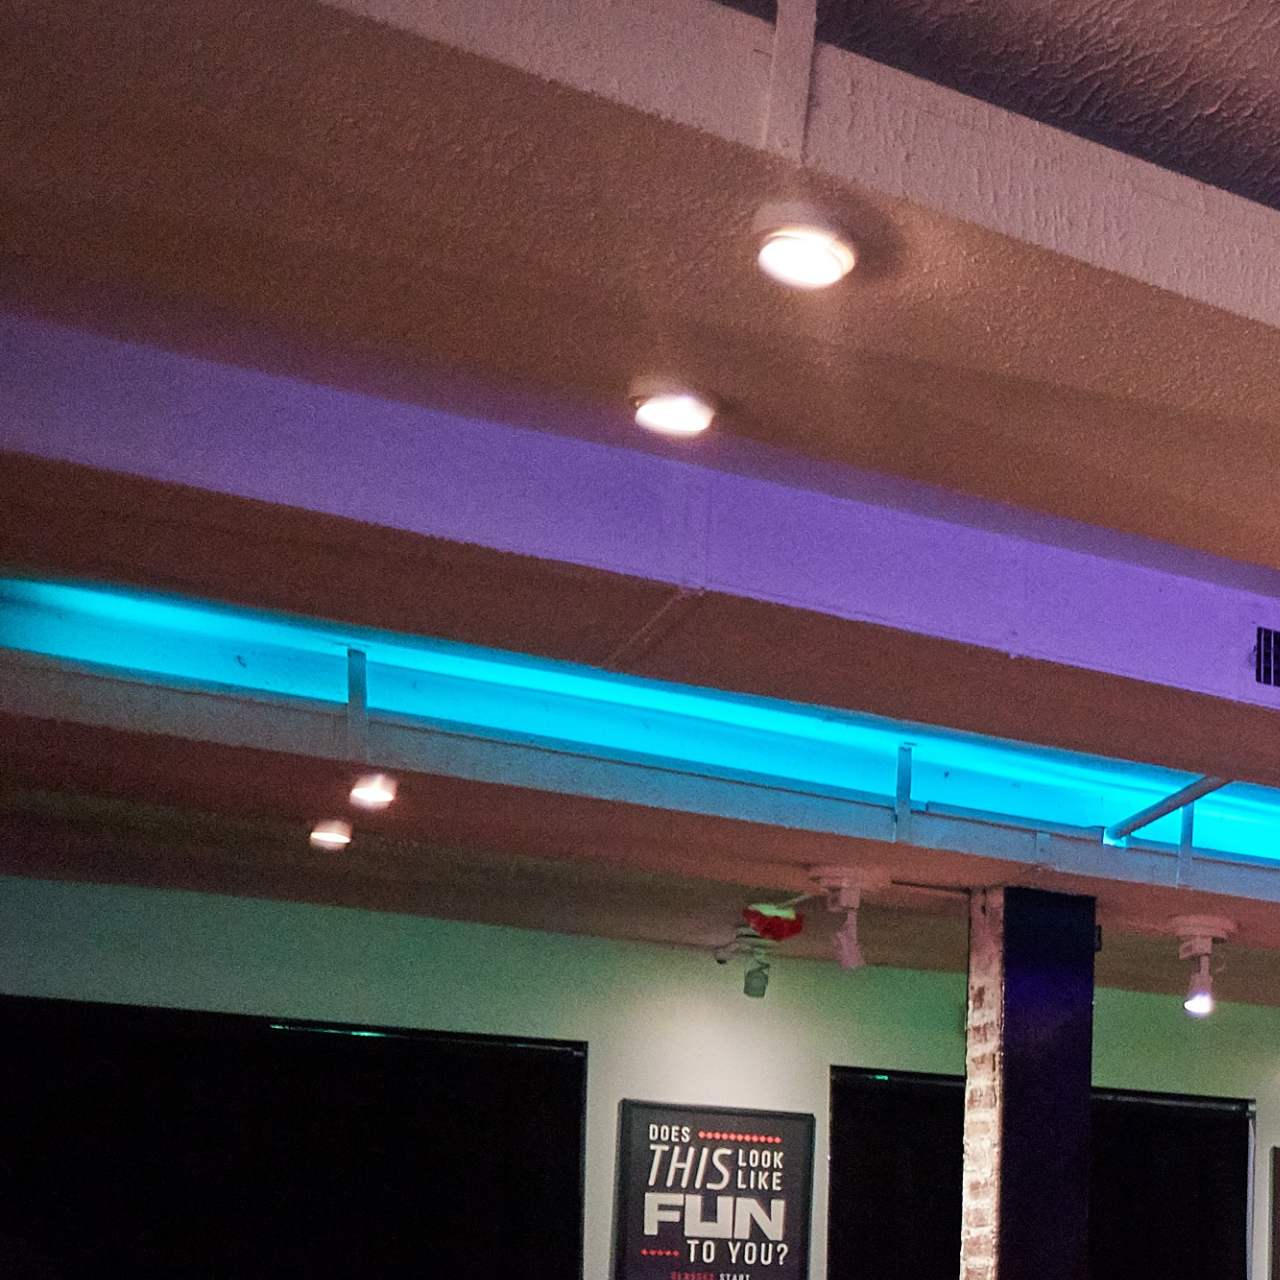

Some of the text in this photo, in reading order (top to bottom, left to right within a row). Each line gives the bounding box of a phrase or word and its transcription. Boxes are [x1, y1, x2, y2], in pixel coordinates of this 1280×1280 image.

[649, 1124, 690, 1142] DOES
[648, 1144, 733, 1190] THIS
[738, 1150, 784, 1168] LOOK
[738, 1171, 783, 1190] LIKE
[643, 1192, 785, 1240] FUN
[687, 1240, 789, 1266] TO YOU?
